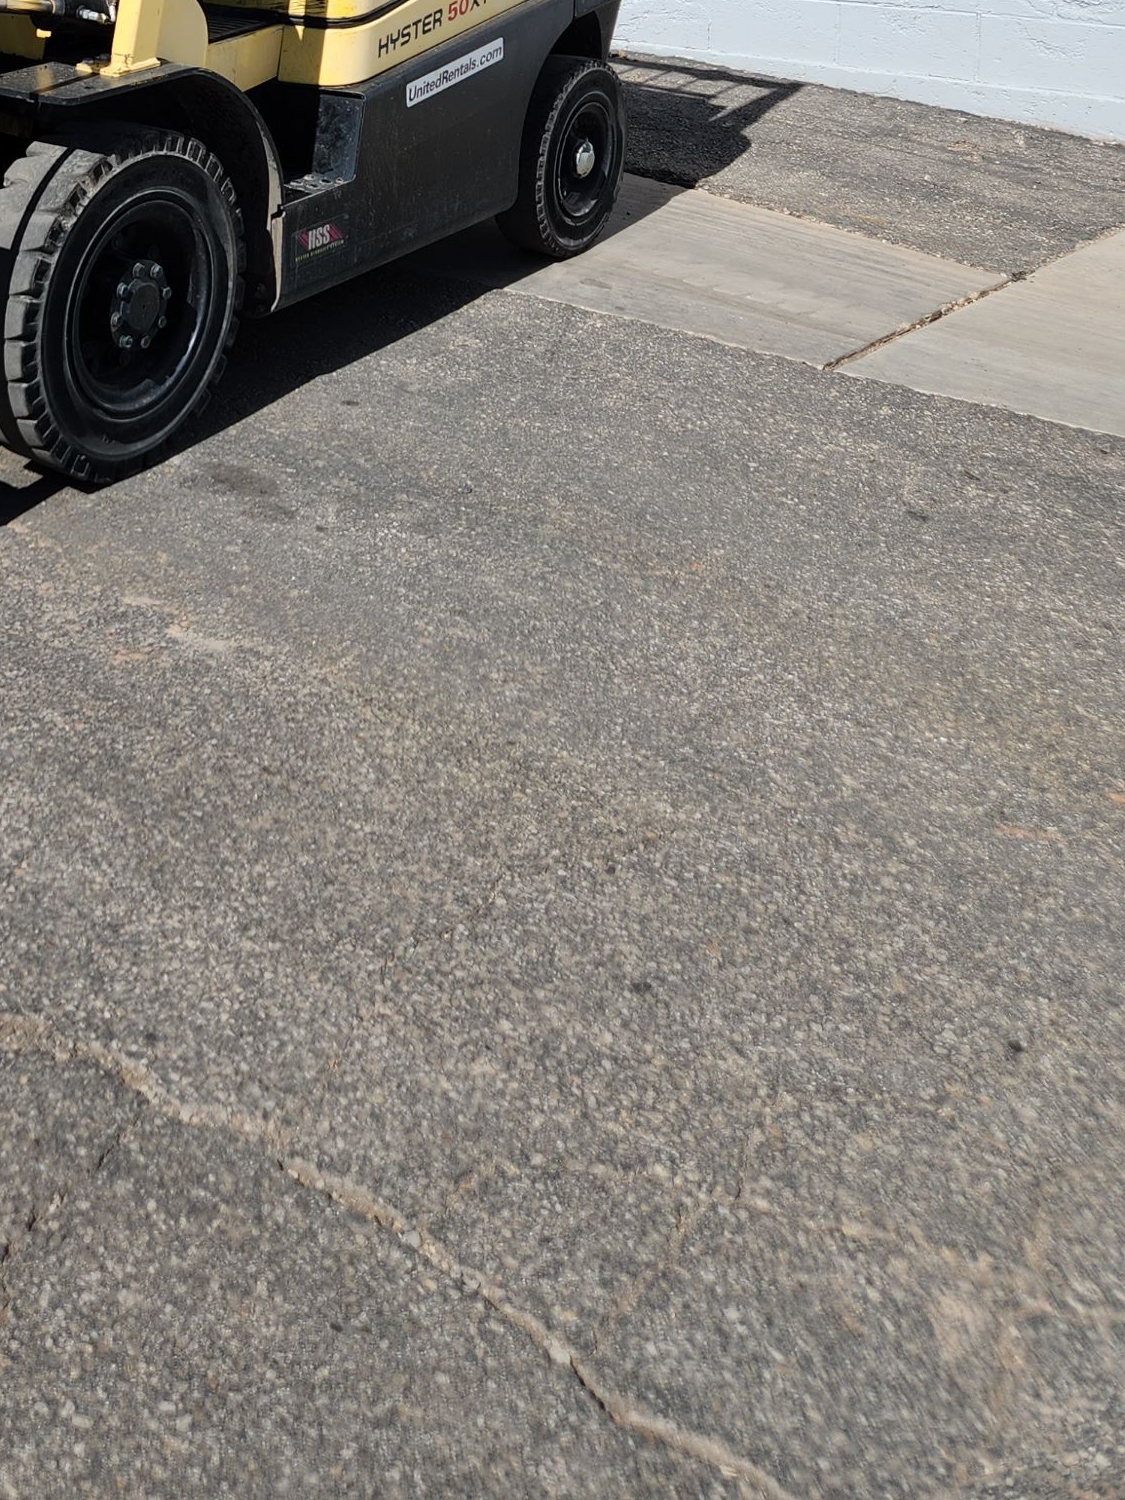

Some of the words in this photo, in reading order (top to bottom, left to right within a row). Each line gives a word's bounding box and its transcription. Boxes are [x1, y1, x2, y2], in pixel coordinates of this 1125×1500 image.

[378, 8, 444, 58] HYSTER
[408, 46, 502, 102] UnitedRentals.com
[308, 224, 330, 251] HSS
